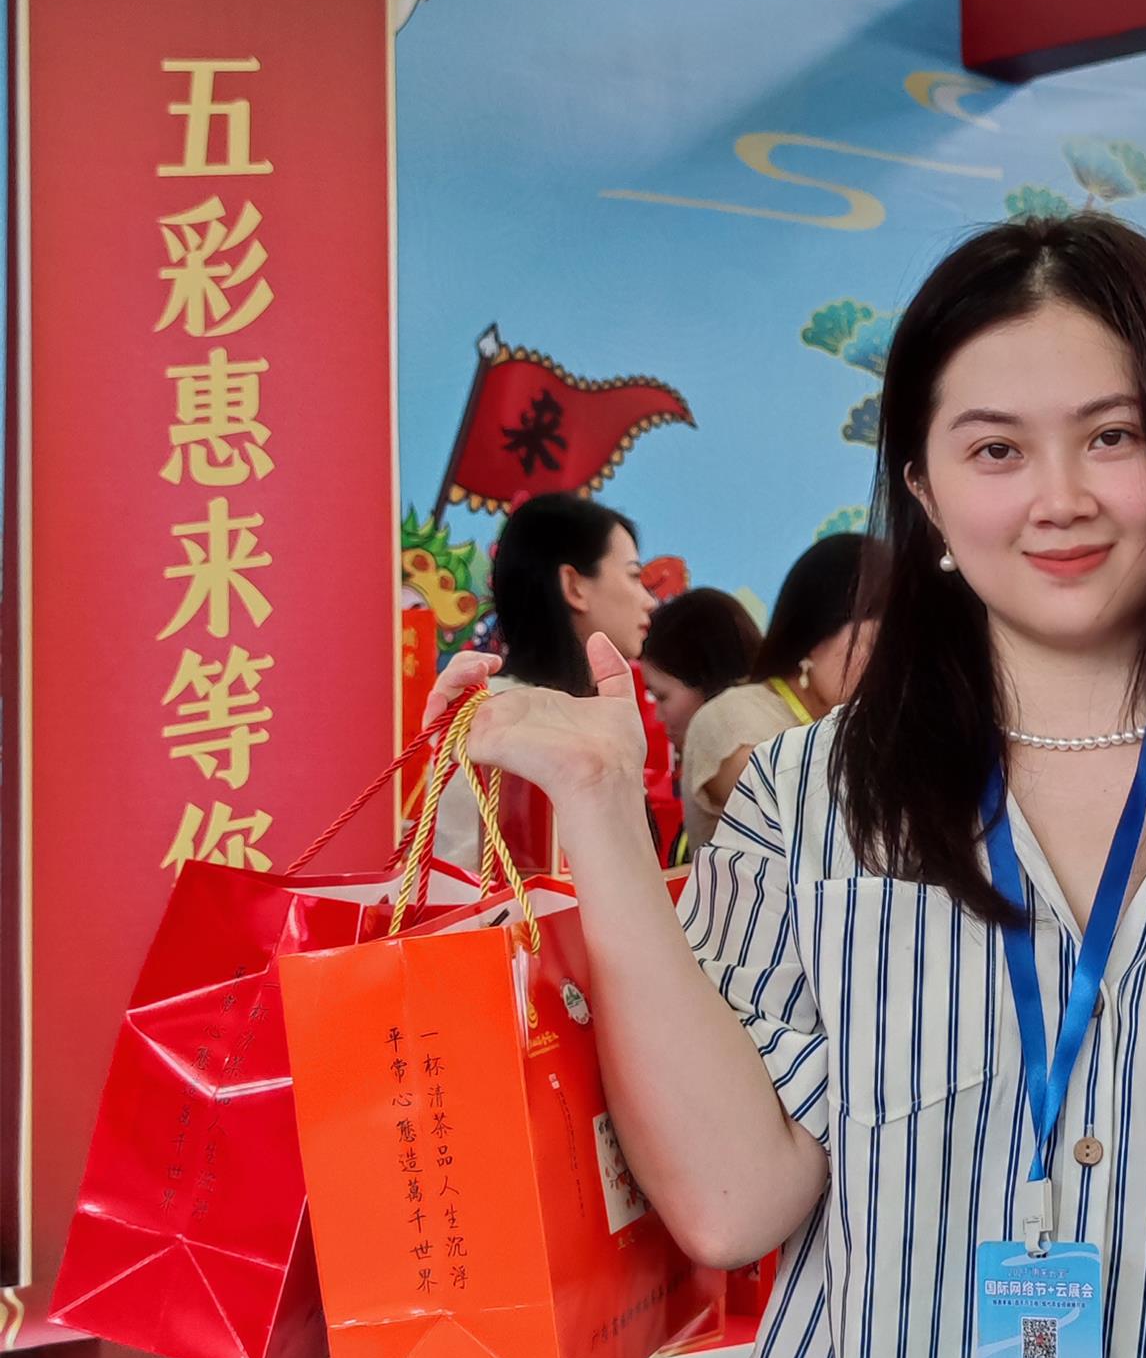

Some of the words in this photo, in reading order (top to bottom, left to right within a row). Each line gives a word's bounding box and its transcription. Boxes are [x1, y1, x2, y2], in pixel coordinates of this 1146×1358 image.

[420, 1032, 468, 1290] 一杯清茶品人生沉浮
